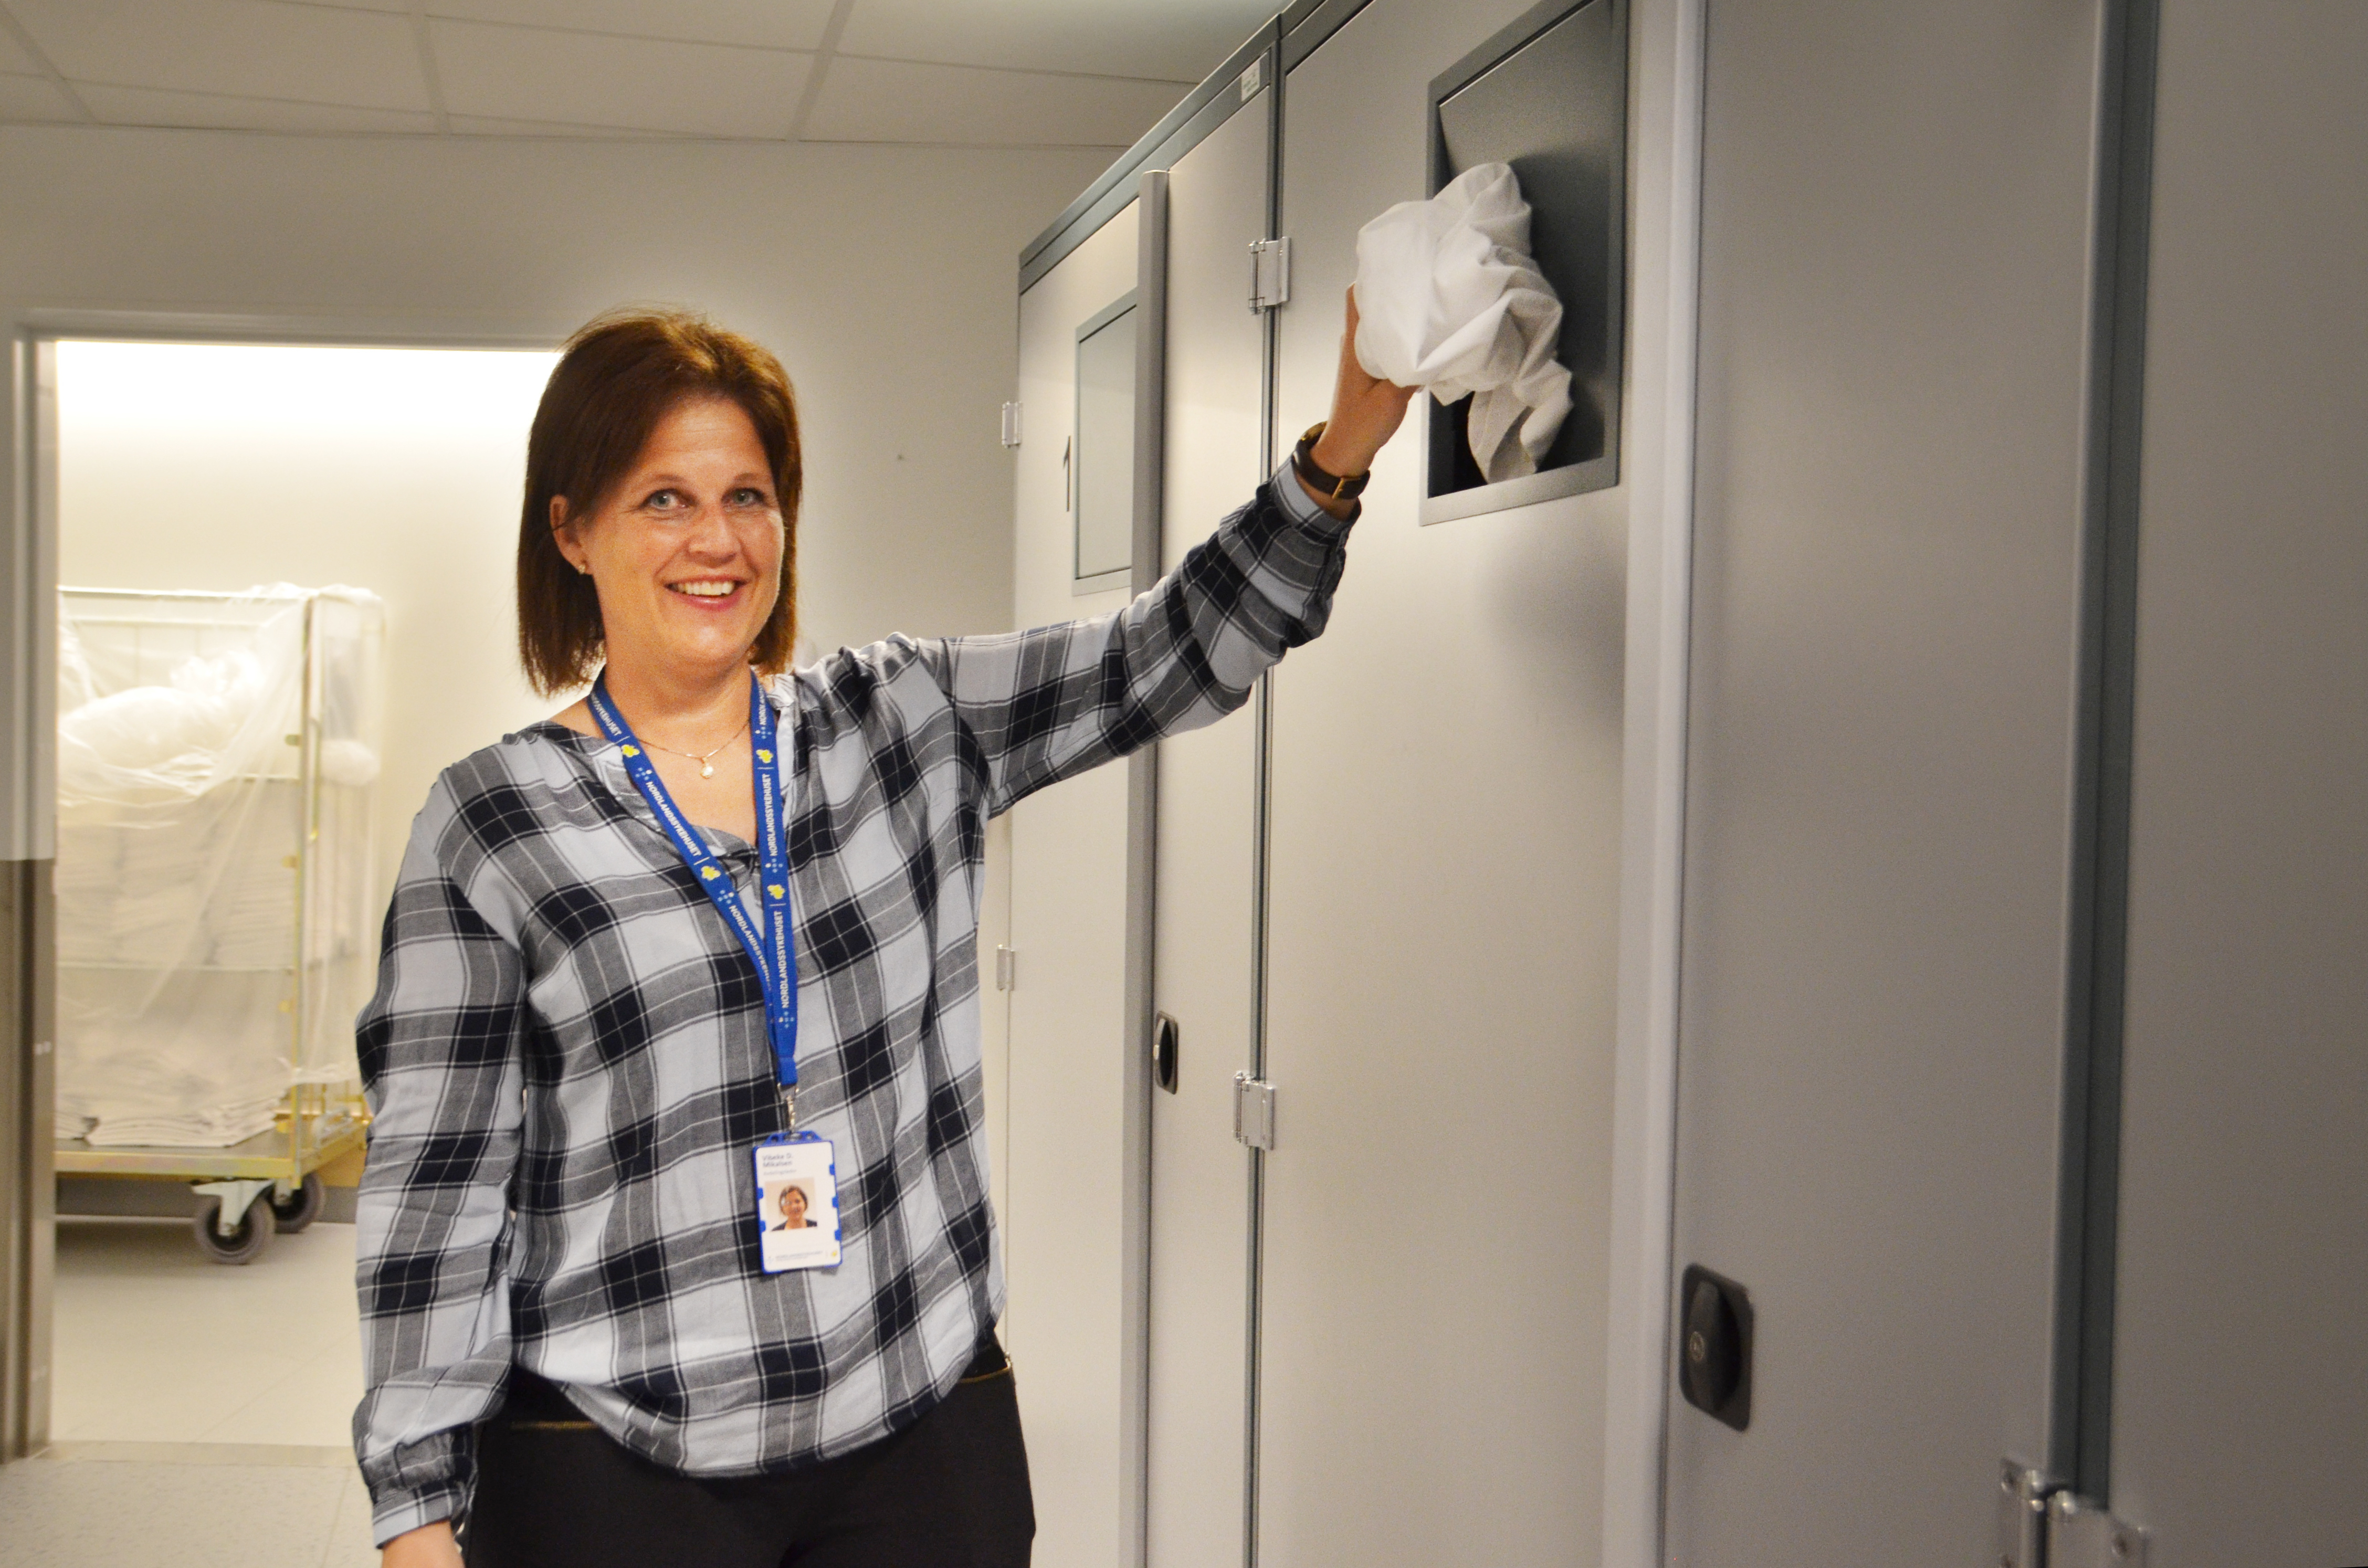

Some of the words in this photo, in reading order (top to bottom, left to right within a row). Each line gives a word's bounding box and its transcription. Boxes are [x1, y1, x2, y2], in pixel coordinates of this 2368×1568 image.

[646, 781, 702, 856] NORDLANDSSYKEHUSET
[762, 773, 778, 856] NORDLANDSSYKEHUSET
[774, 911, 790, 1008] NORDLANDSSYKEHUSET
